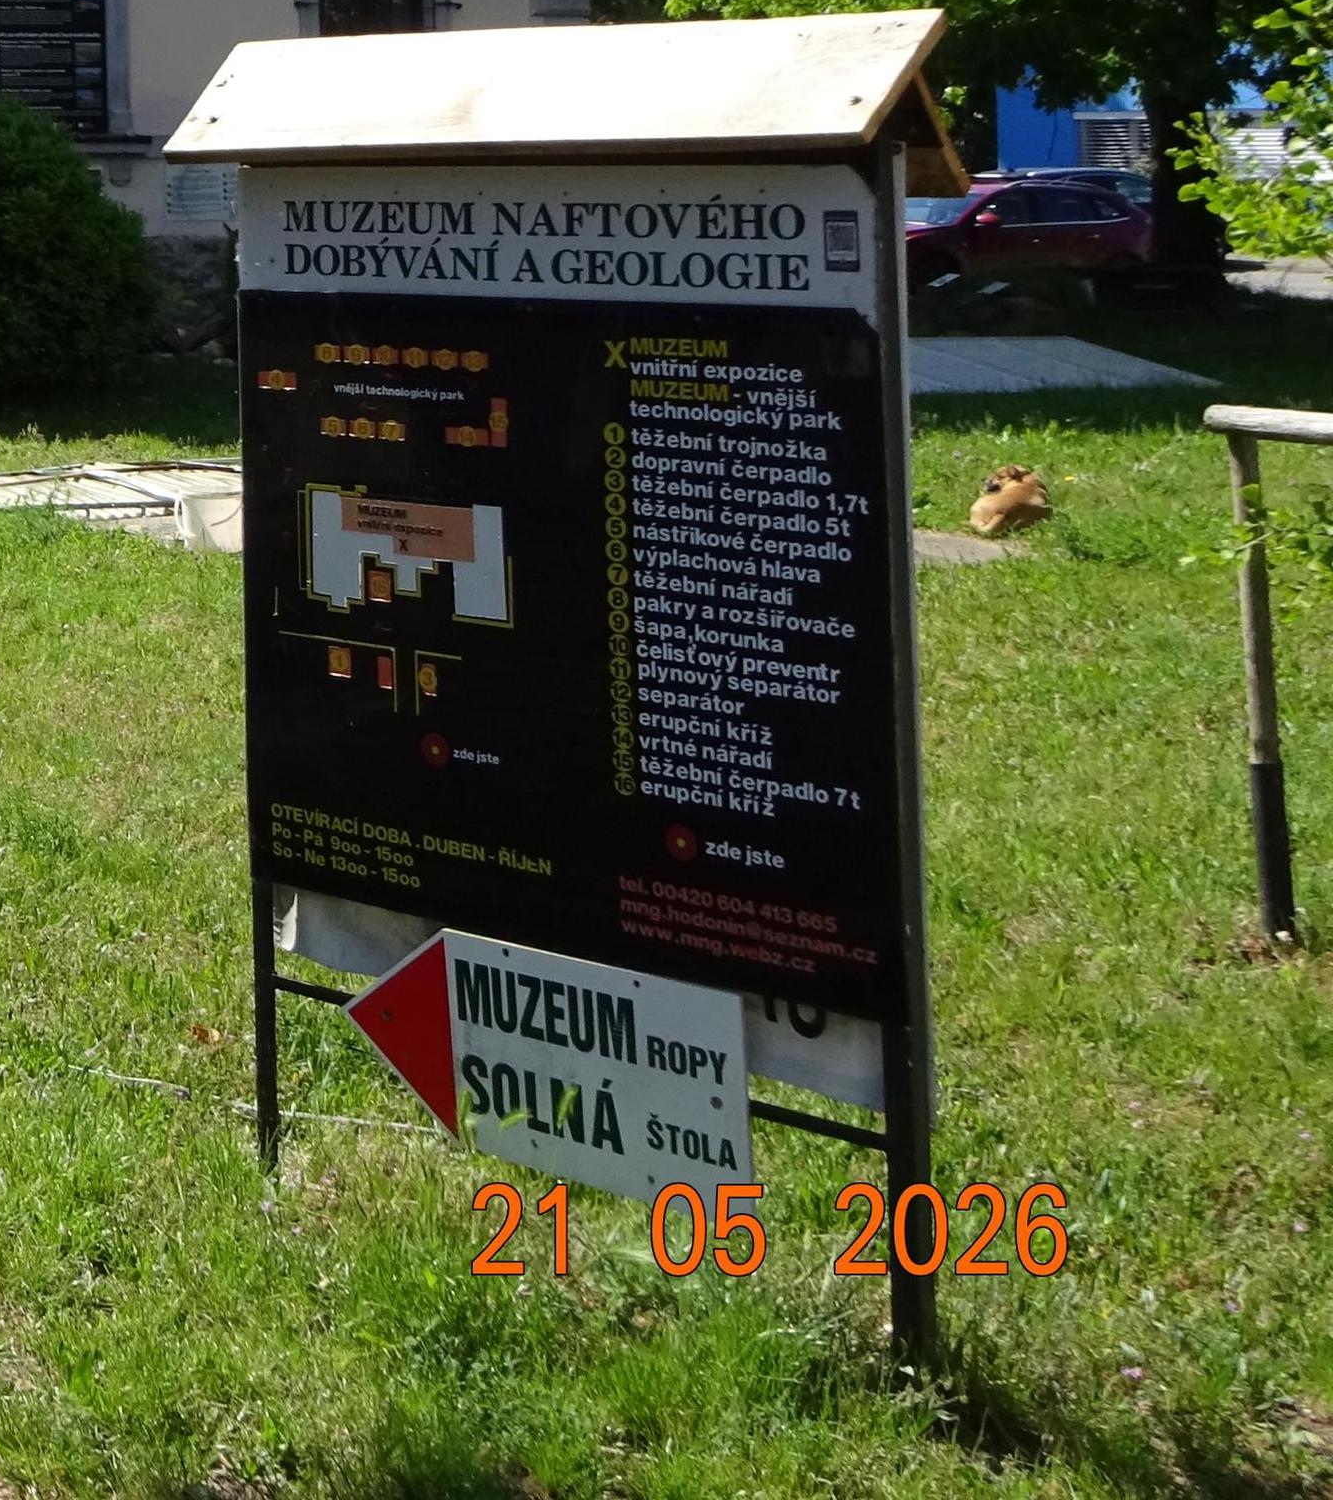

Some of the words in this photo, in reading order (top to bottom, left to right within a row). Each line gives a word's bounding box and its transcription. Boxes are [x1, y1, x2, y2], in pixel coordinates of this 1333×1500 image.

[283, 200, 475, 235] MUZEUM
[491, 196, 806, 240] NAFTOVÉHO
[284, 236, 500, 282] DOBÝVÁNÍ
[512, 249, 545, 283] A
[549, 250, 810, 291] GEOLOGIE
[604, 341, 627, 368] X
[630, 338, 728, 357] MUZEUM
[630, 358, 697, 378] vnitřní
[704, 364, 803, 383] expozice
[334, 382, 364, 396] vnější
[365, 385, 438, 401] technologický
[440, 388, 465, 401] park
[630, 380, 730, 401] MUZEUM
[746, 388, 818, 411] vnější
[629, 400, 784, 430] technologický
[789, 410, 843, 430] park
[631, 428, 714, 451] těžební
[718, 435, 827, 460] trojnožka
[632, 451, 725, 475] dopravní
[731, 459, 832, 486] čerpadlo
[357, 505, 407, 519] MUZEUM
[632, 474, 714, 499] těžební
[719, 482, 820, 509] čerpadlo
[825, 493, 870, 515] 1,7t
[632, 498, 715, 523] těžební
[720, 506, 821, 534] čerpadlo
[825, 517, 852, 537] 5t
[399, 539, 408, 551] X
[633, 522, 745, 550] nástřikové
[750, 534, 852, 562] čerpadlo
[633, 546, 757, 576] výplachová
[761, 559, 821, 584] hlava
[633, 570, 717, 597] těžební
[721, 582, 793, 606] nářadí
[633, 595, 695, 620] pakry
[701, 605, 714, 620] a
[719, 607, 856, 638] rozšiřovače
[638, 661, 723, 691] plynový
[727, 674, 841, 704] separátor
[742, 657, 841, 683] preventr
[638, 687, 745, 715] separátor
[639, 712, 720, 738] erupční
[726, 721, 773, 746] kříž
[452, 748, 474, 761] zde
[475, 750, 500, 765] jste
[639, 734, 697, 758] vrtné
[702, 744, 773, 770] nářadí
[639, 755, 722, 786] těžební
[728, 769, 830, 804] čerpadlo
[640, 781, 723, 808] erupční
[728, 792, 775, 817] kříž
[271, 803, 359, 835] OTEVÍRACÍ
[363, 822, 412, 847] DOBA
[423, 835, 485, 862] DUBEN
[497, 846, 553, 876] ŘÍJEN
[272, 822, 292, 839] Po
[272, 841, 293, 858] So
[304, 847, 326, 867] Ne
[704, 840, 742, 860] zde
[743, 845, 786, 868] jste
[619, 875, 650, 896] tel.
[652, 881, 714, 908] 00420
[716, 893, 754, 917] 604
[454, 958, 637, 1064] MUZEUM
[647, 1035, 727, 1085] ROPY
[461, 1054, 624, 1155] SOLNÁ
[646, 1112, 737, 1171] ŠTOLA
